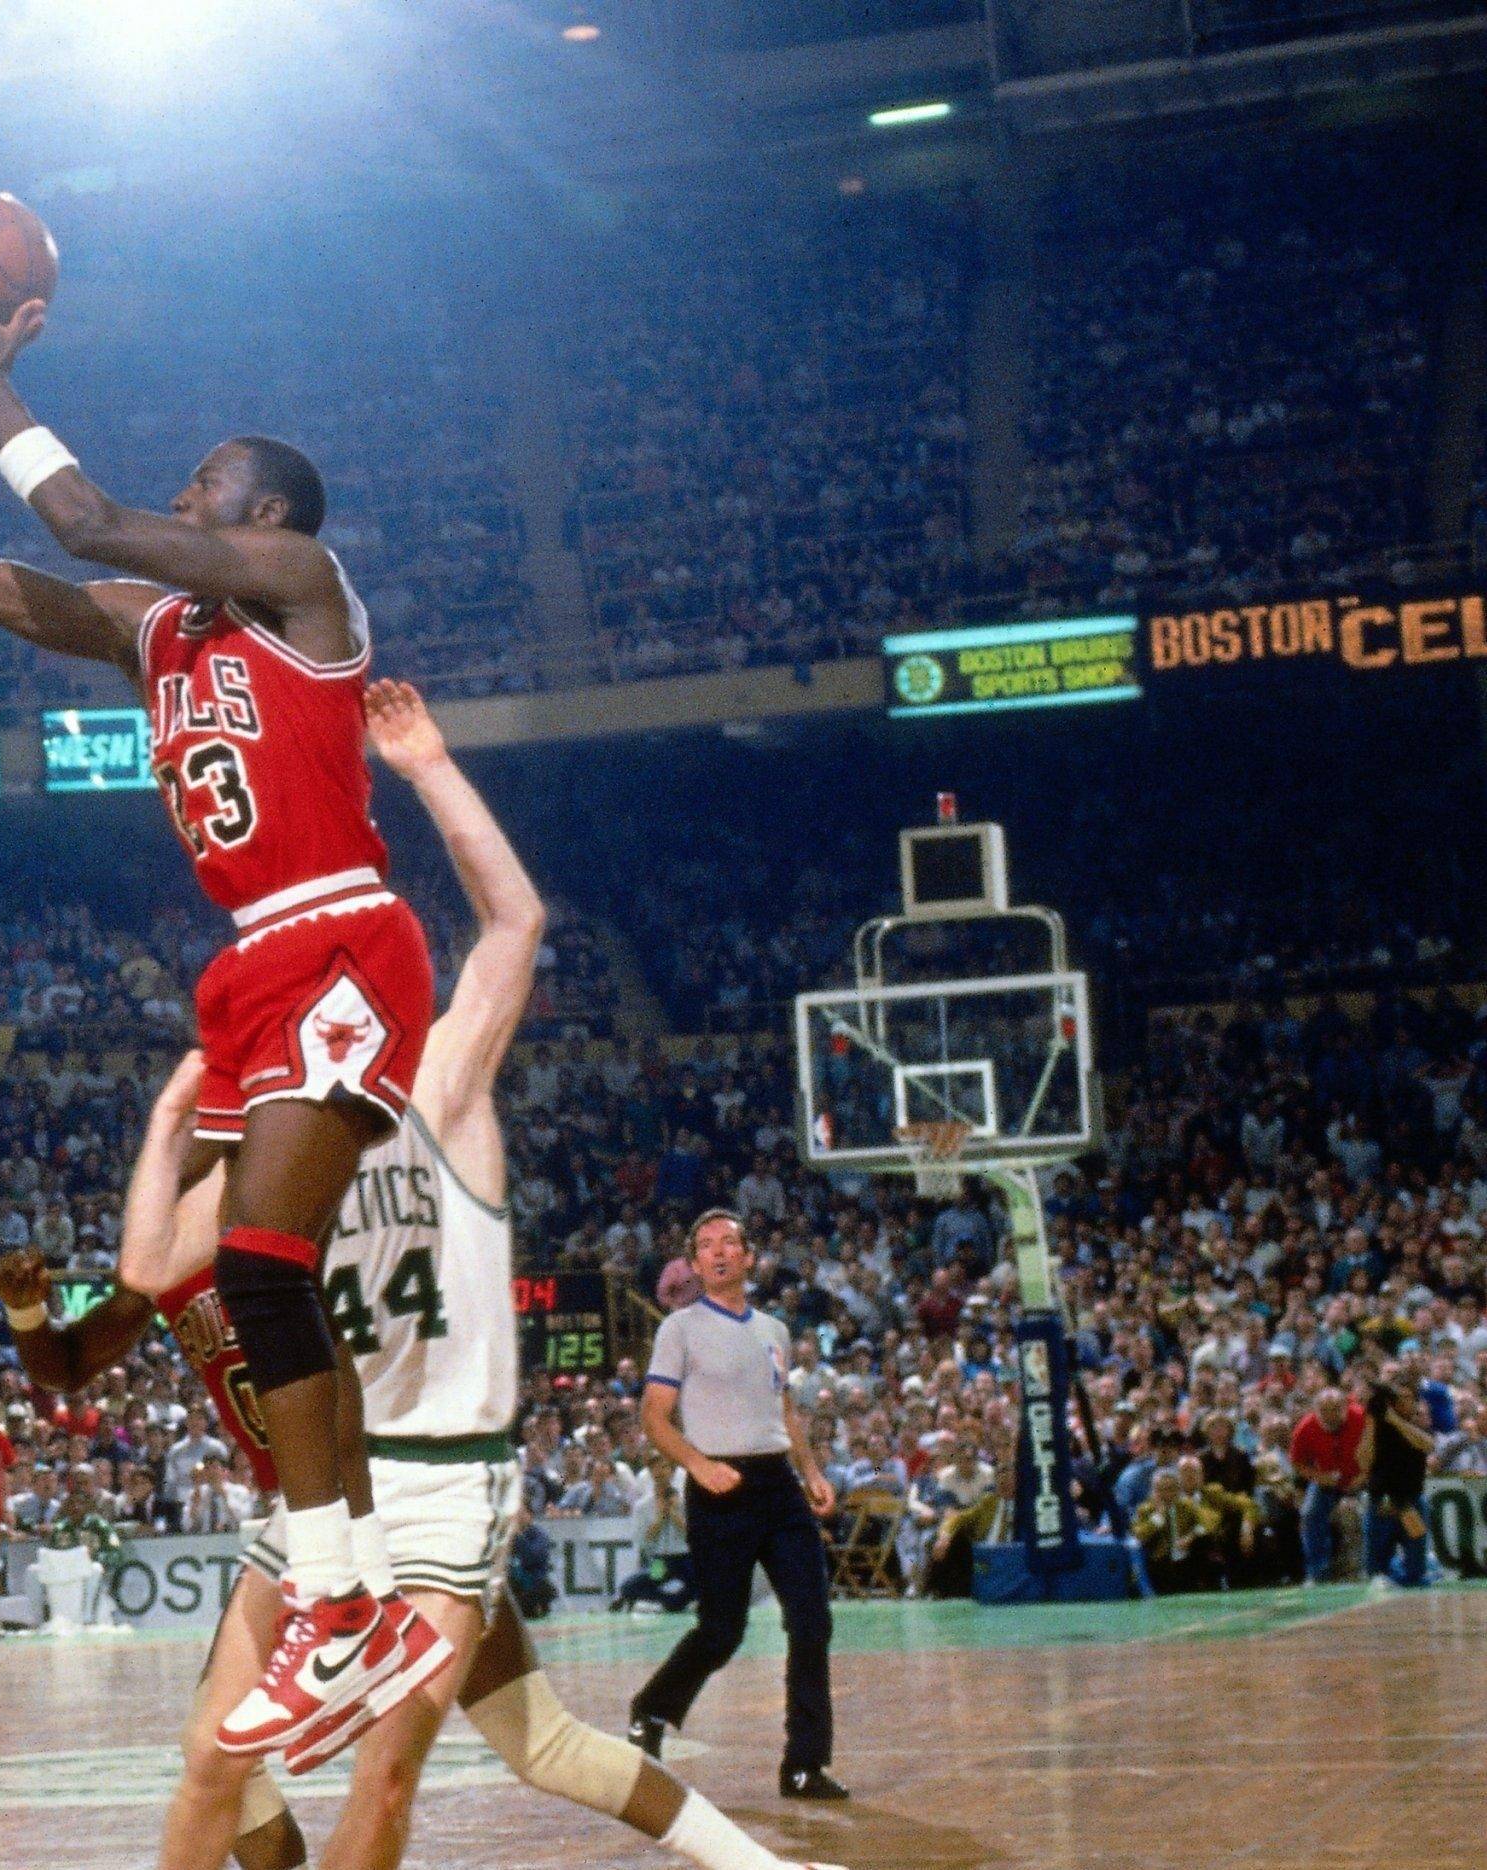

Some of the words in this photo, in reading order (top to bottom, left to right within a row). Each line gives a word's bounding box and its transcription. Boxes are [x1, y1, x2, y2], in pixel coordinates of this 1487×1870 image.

[1150, 599, 1333, 671] BOSTON
[959, 645, 1046, 675] BOSTON
[973, 667, 1059, 699] SPORTS
[323, 1245, 448, 1354] 44
[546, 1332, 604, 1370] 125
